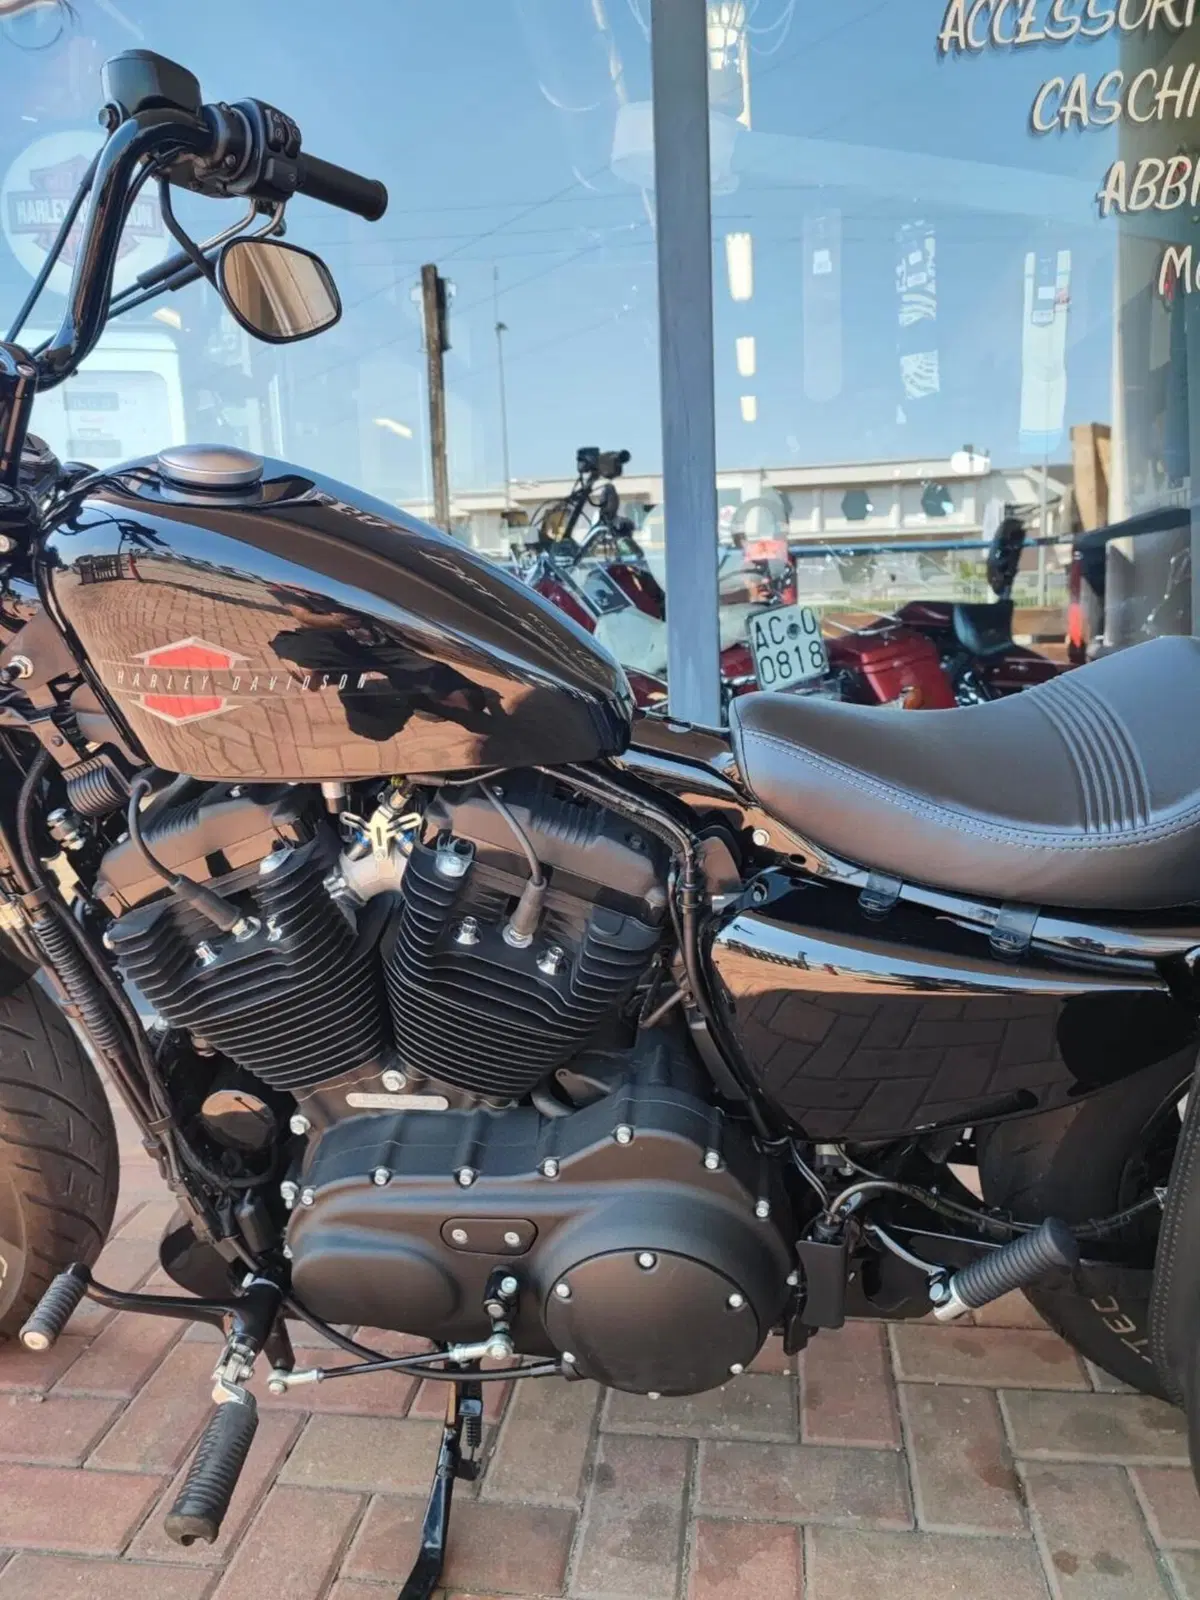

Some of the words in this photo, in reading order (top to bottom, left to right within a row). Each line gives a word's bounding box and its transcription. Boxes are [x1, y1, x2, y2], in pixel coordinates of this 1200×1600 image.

[1158, 245, 1200, 295] M
[755, 616, 785, 652] AC
[760, 640, 824, 684] 0818
